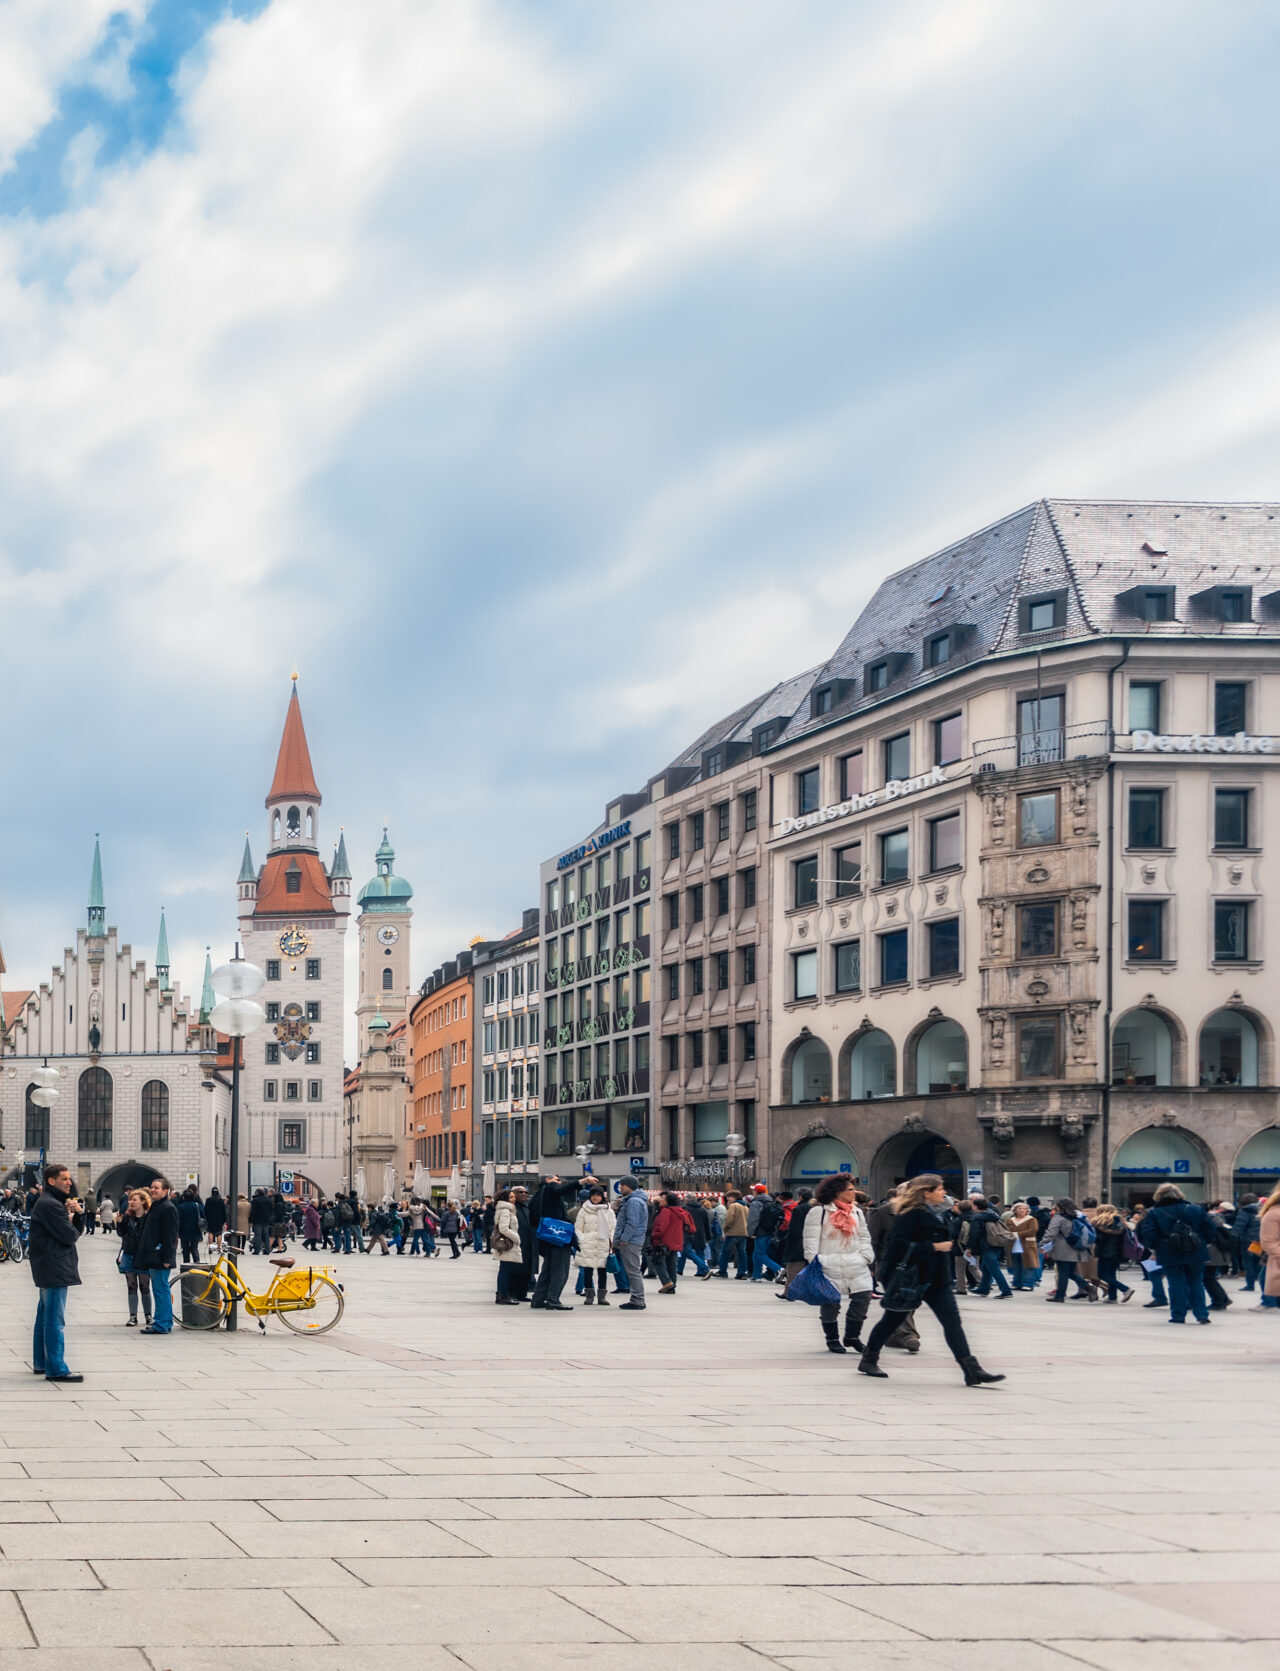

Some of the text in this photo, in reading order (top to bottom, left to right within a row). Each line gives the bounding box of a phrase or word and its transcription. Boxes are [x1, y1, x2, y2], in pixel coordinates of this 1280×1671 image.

[1132, 730, 1272, 752] Deutsche
[780, 766, 948, 835] Deutsche Bank
[556, 820, 632, 871] AUGEN KLINIK
[283, 1170, 293, 1181] S
[283, 1182, 293, 1193] U
